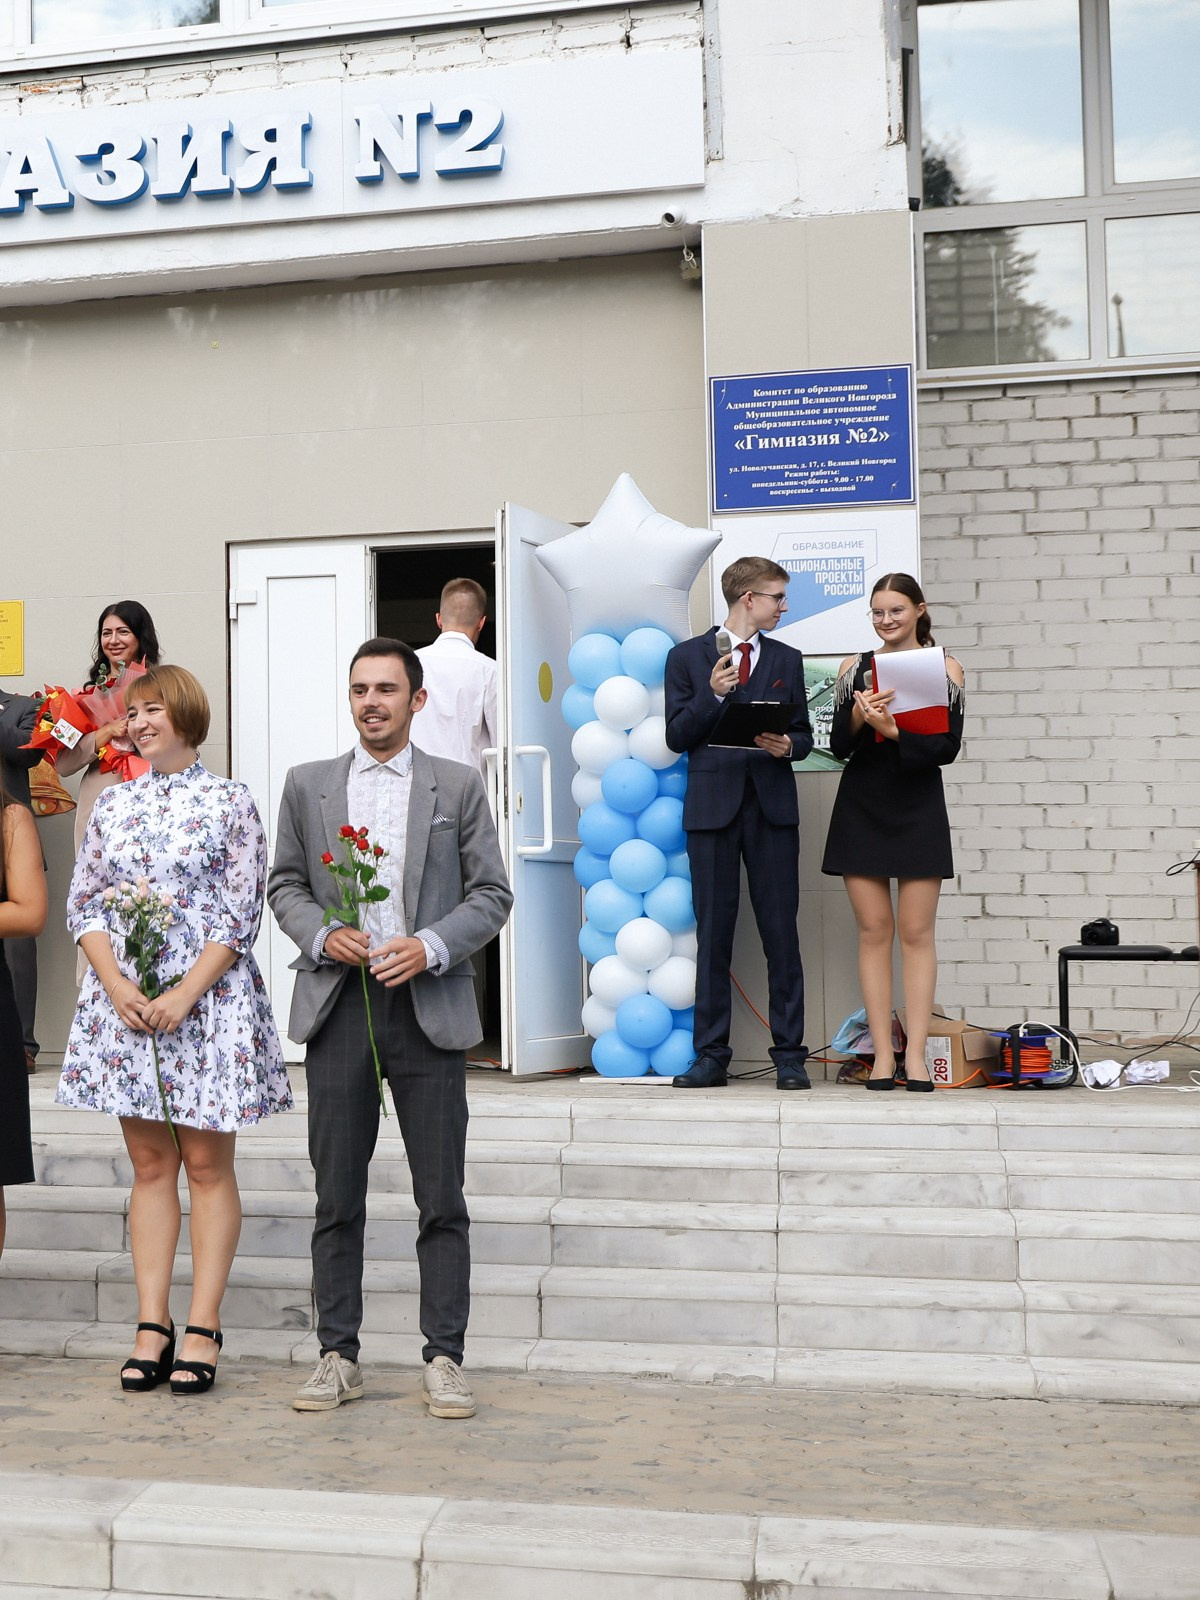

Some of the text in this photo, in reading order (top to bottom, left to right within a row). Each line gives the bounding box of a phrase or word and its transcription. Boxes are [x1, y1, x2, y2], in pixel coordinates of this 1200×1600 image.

[753, 388, 792, 397] Комитет
[807, 384, 868, 395] образованию
[725, 393, 897, 410] Администрации Великого Новгорода
[745, 404, 877, 420] Муниципальное автономное
[733, 415, 890, 430] общеобразовательное учреждение
[734, 427, 890, 450] «Гимназия №2»
[827, 459, 860, 467] Великий
[861, 458, 897, 466] Новгород
[810, 469, 840, 477] работы:
[769, 488, 814, 496] воскресенье
[792, 540, 865, 551] ОБРАЗОВАНИЕ
[779, 558, 863, 573] НАЦИОНАЛЬНЫЕ
[815, 571, 863, 584] ПРОЕКТЫ
[824, 583, 864, 596] РОССИИ
[933, 1058, 948, 1082] 269
